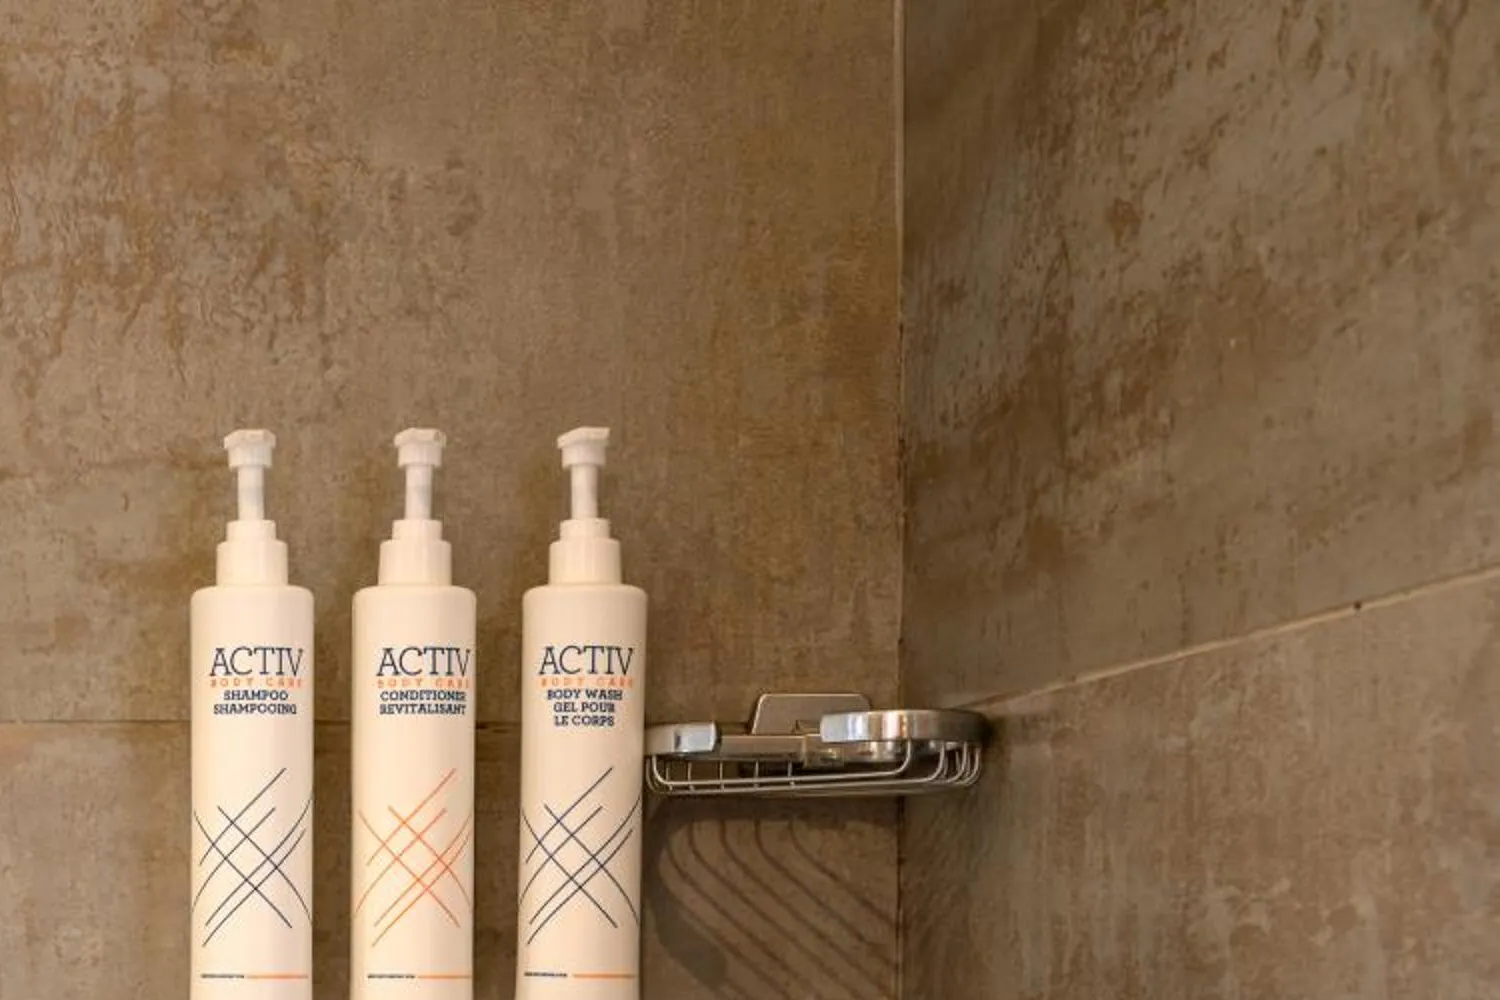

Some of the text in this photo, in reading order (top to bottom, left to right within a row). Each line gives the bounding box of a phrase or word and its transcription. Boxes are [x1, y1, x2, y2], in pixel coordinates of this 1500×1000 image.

[209, 646, 304, 676] ACTIV
[376, 646, 471, 677] ACTIV
[538, 645, 634, 675] ACTIV
[209, 678, 255, 687] BODY
[377, 678, 423, 688] BODY
[540, 678, 585, 687] BODY
[223, 690, 289, 701] SHAMPOO
[380, 690, 467, 701] CONDITIONER
[547, 689, 623, 700] BODY WASH
[213, 703, 297, 715] SHAMPOOING
[379, 703, 466, 715] REVITALISANT
[553, 702, 615, 713] GEL POUR
[554, 715, 615, 727] LE CORPS
